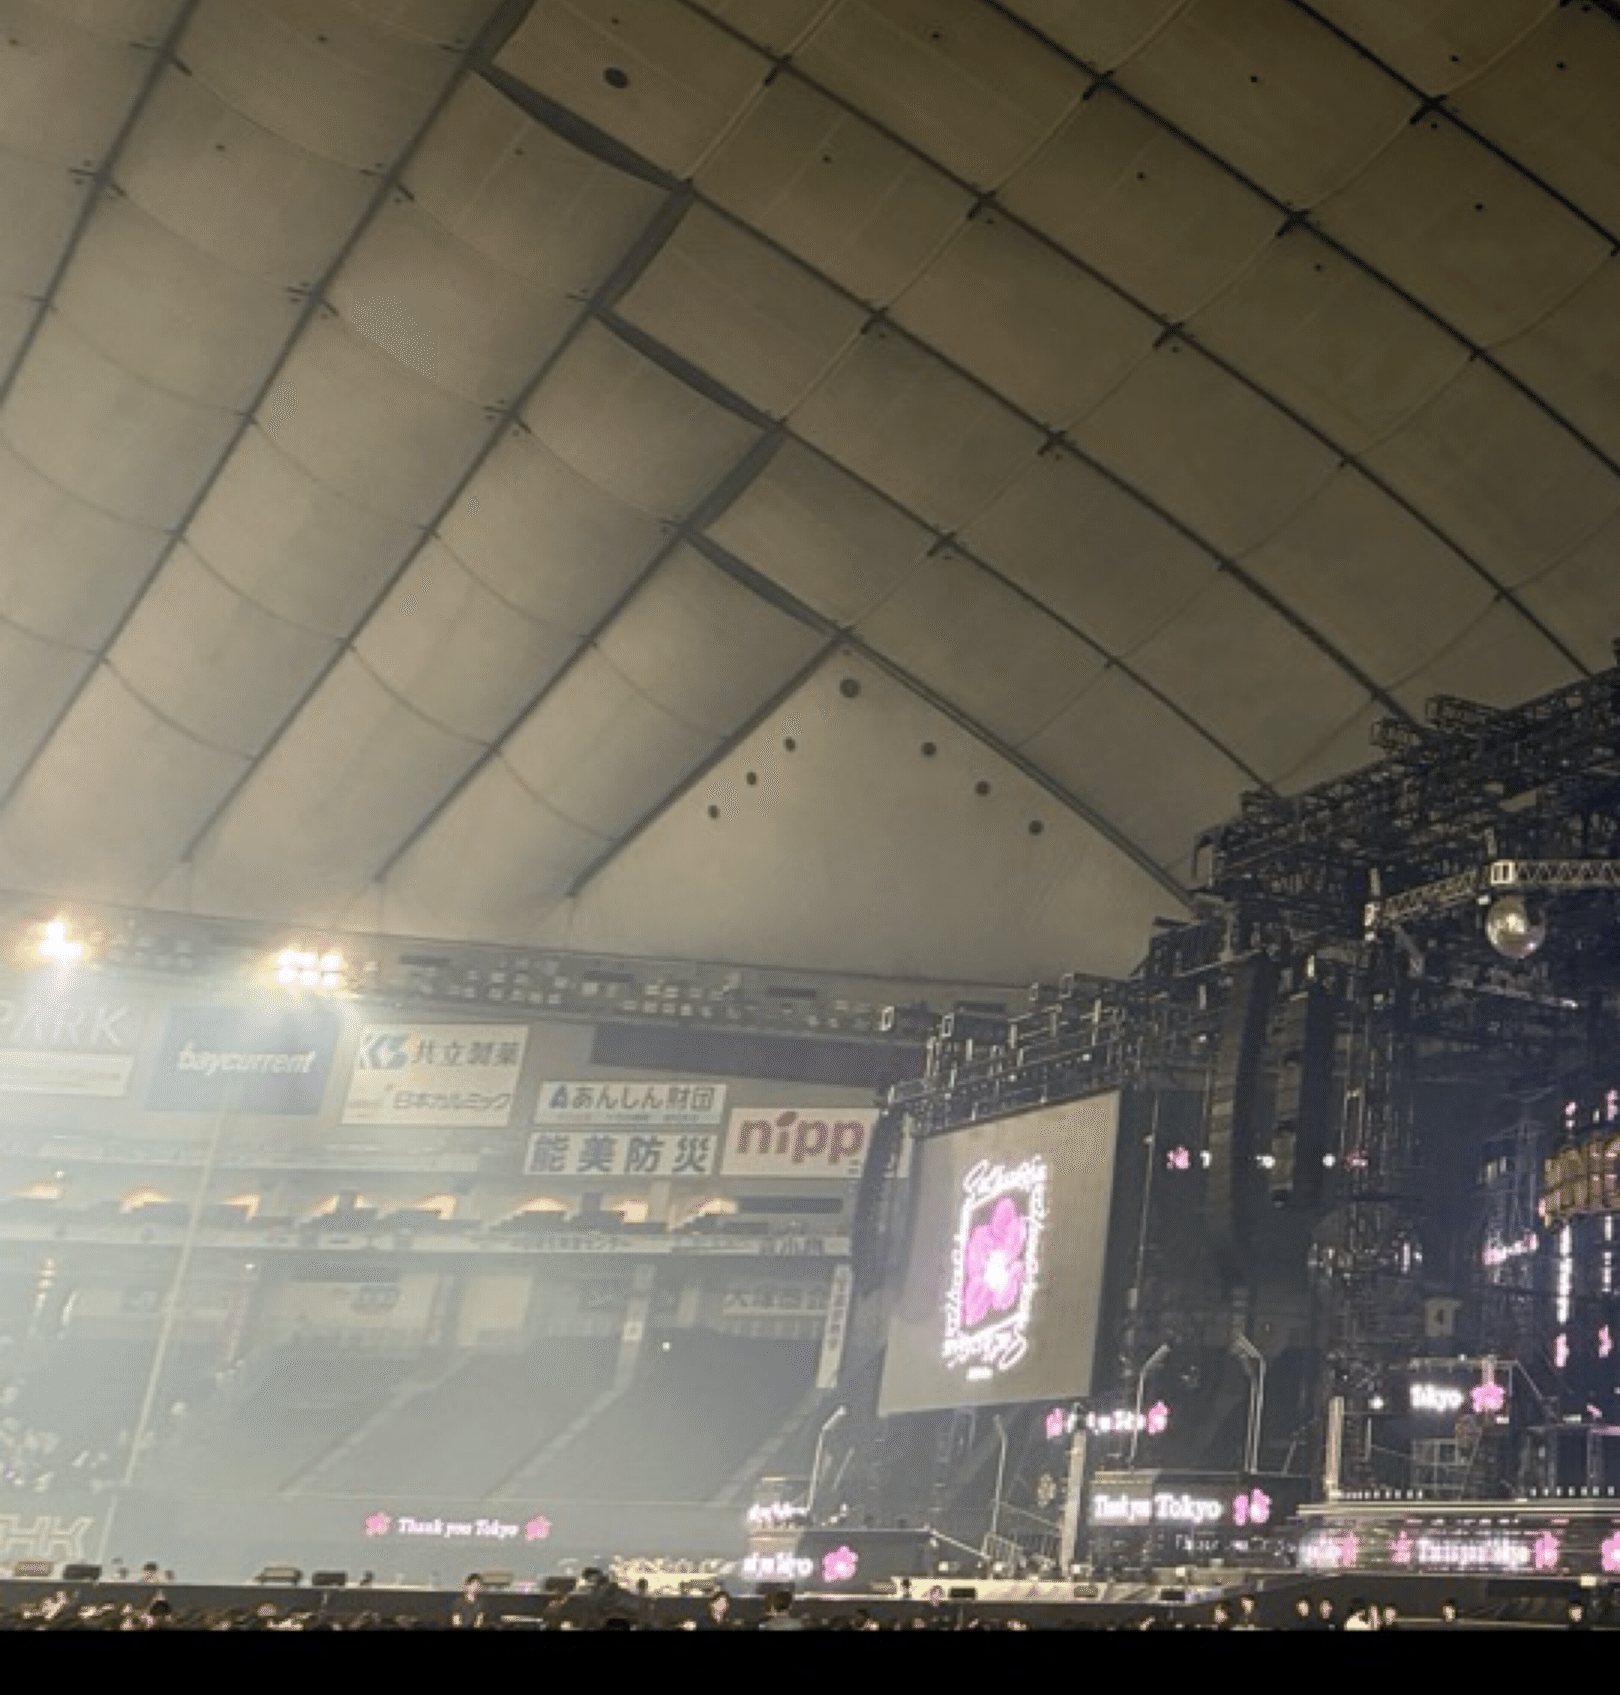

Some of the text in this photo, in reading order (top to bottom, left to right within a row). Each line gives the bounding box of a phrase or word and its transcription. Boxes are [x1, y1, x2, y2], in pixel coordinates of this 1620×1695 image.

[177, 1041, 317, 1077] baycurrent
[571, 1086, 716, 1112] あんしん財団
[531, 1134, 712, 1174] 能美防災
[1154, 1491, 1223, 1524] Tokyo
